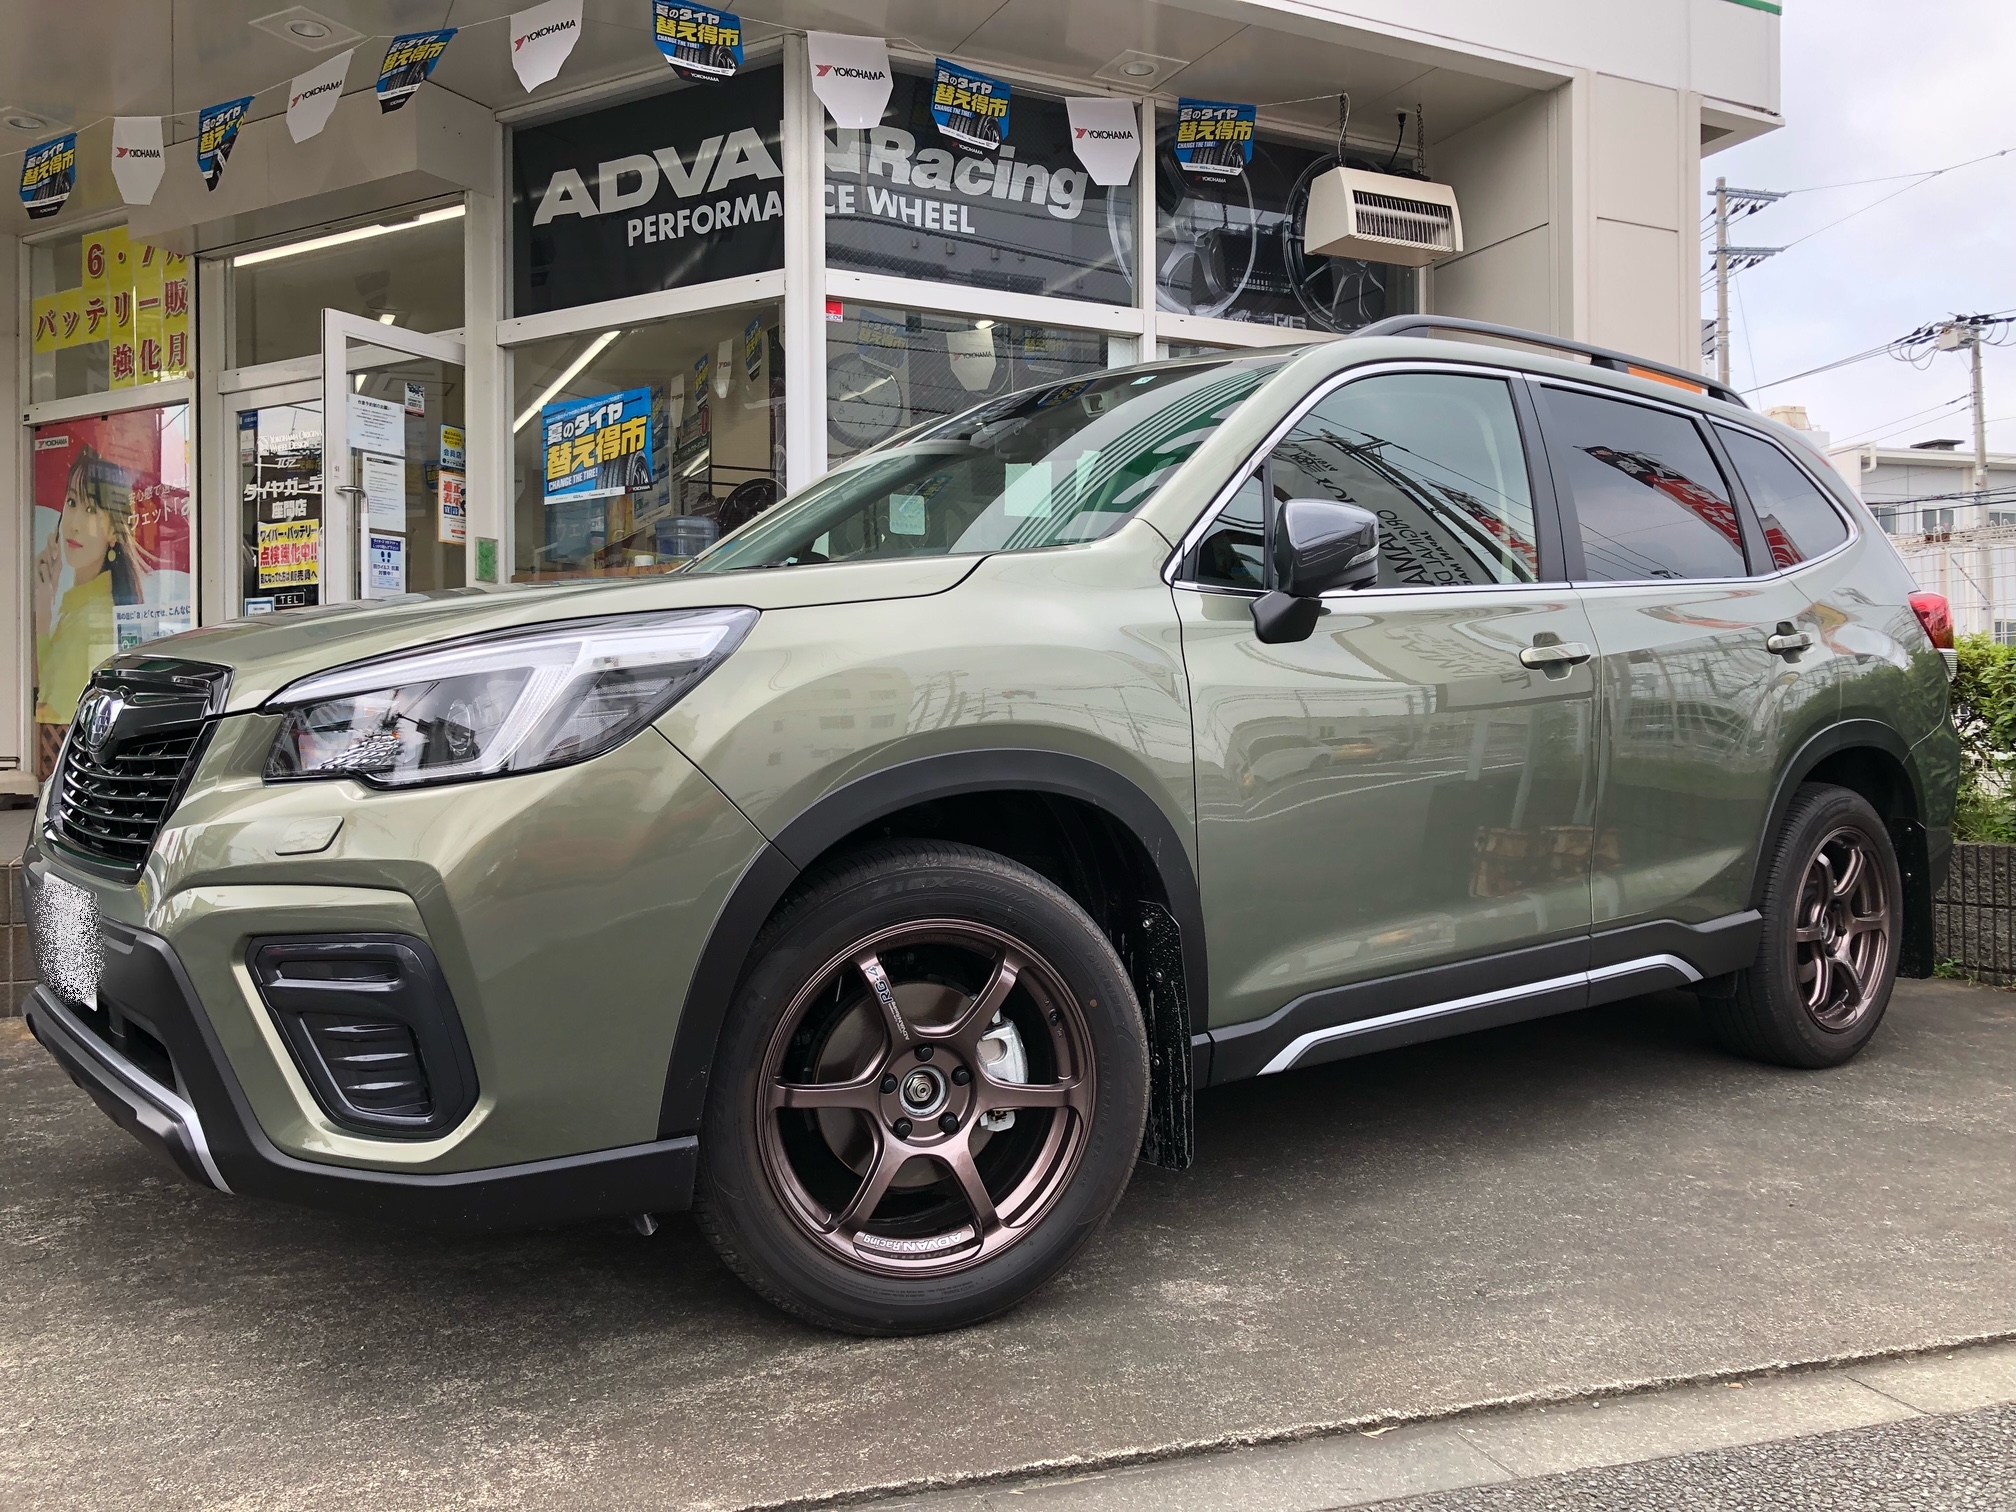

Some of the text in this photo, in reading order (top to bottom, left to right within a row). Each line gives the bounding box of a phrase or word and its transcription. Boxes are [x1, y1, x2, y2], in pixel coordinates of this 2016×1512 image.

[526, 19, 576, 42] YOKOHAMA
[656, 15, 740, 46] 替え得市
[382, 41, 447, 74] 替え得市
[691, 72, 720, 82] YOKOHAMA
[833, 66, 886, 81] YOKOHAMA
[934, 82, 1009, 117] 替え得市
[1088, 129, 1133, 140] YOKOHAMA
[1178, 121, 1253, 142] 替え得市
[129, 149, 160, 158] YOKOHAMA
[958, 144, 984, 155] YOKOHAMA
[23, 148, 75, 186] 替え得市
[868, 124, 1089, 220] Racing
[867, 186, 976, 234] WHEEL
[547, 402, 624, 446] 夏のタイヤ
[547, 415, 647, 481] 替え得市
[244, 474, 323, 501] タイヤガーデ
[548, 467, 598, 492] CHANGE THE TIRE!
[272, 499, 307, 519] 座間店
[280, 595, 299, 604] TEL
[867, 965, 894, 1005] RG-4
[863, 1232, 962, 1251] ADVAN Racing
